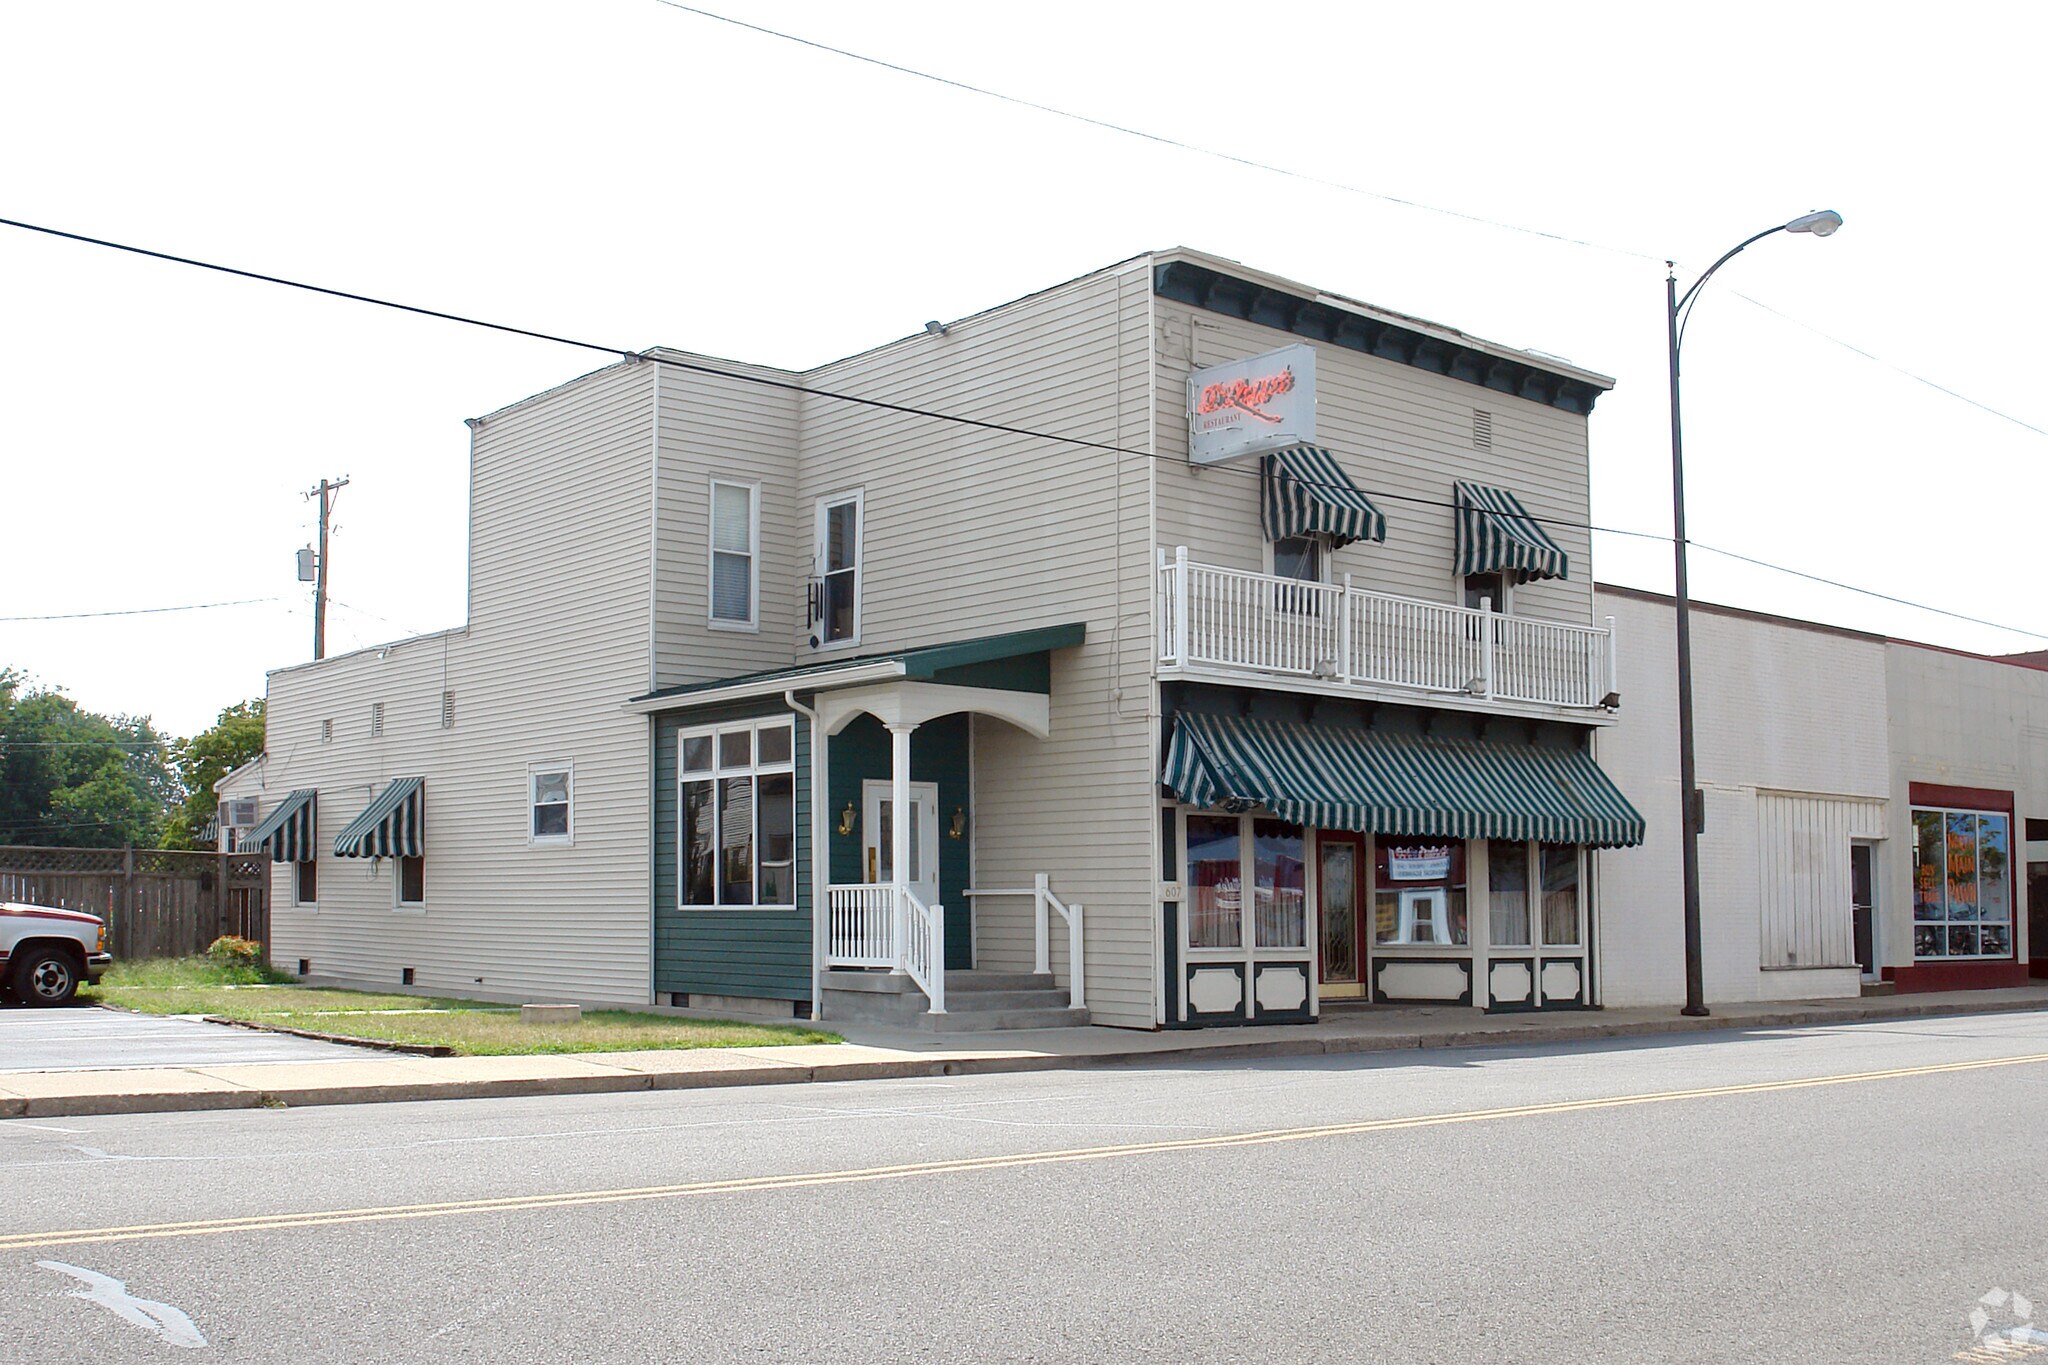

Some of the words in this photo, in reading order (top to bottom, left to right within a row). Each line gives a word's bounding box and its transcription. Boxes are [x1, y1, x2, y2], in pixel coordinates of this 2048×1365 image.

[1203, 413, 1241, 429] RESTAURANT
[1948, 853, 1975, 877] MAIN
[1919, 876, 1936, 888] SELL
[1165, 886, 1181, 897] 607
[1948, 878, 1976, 904] PAWN
